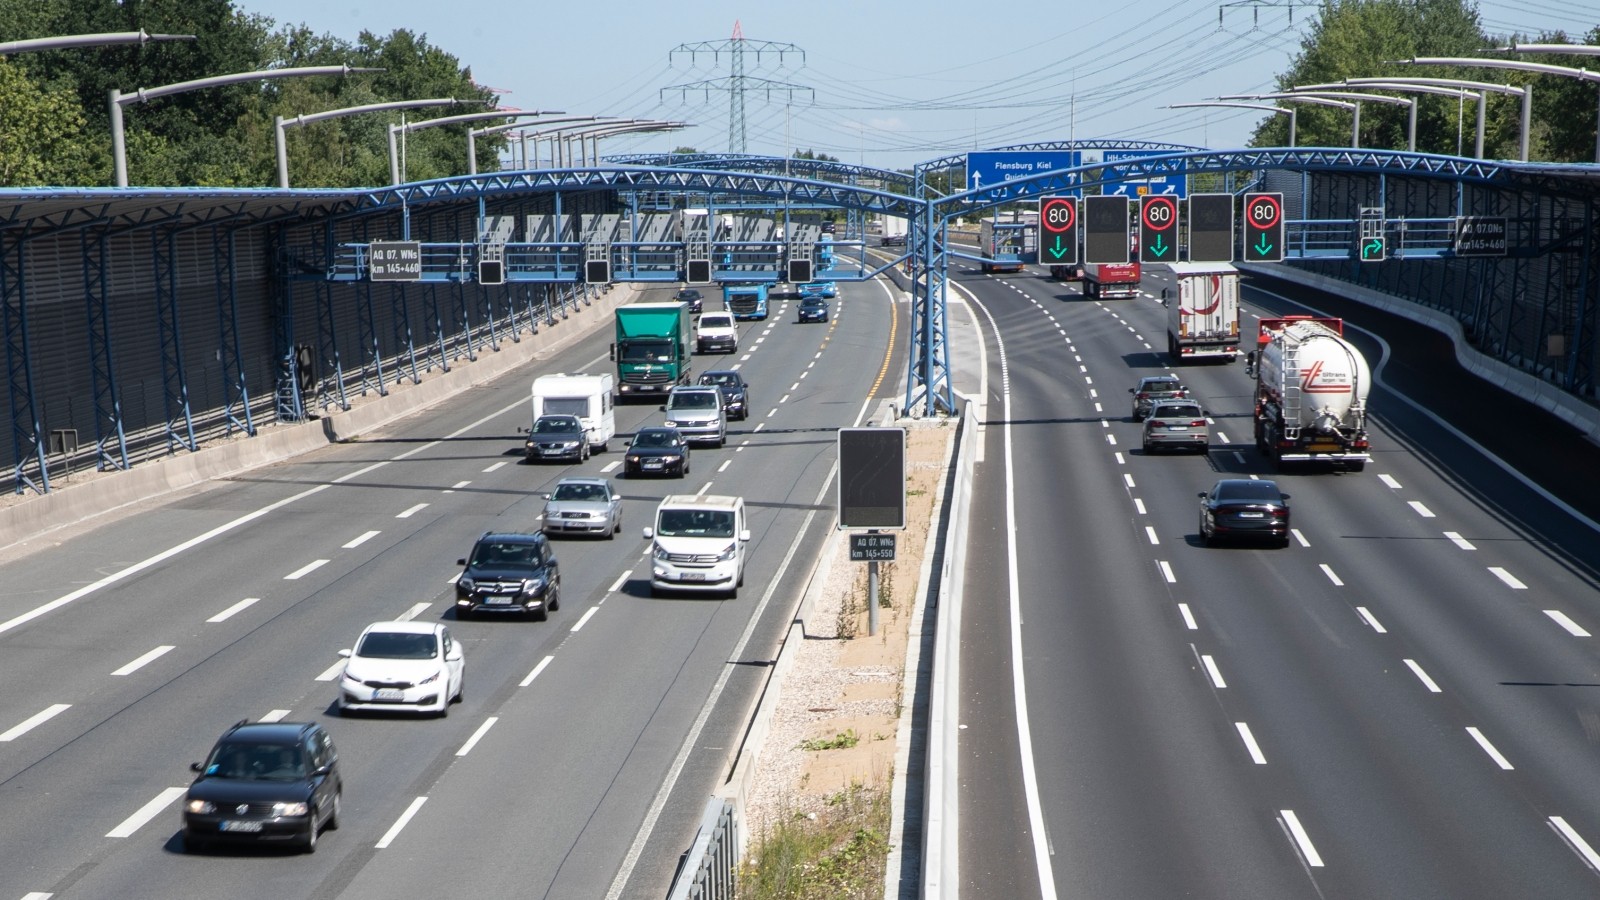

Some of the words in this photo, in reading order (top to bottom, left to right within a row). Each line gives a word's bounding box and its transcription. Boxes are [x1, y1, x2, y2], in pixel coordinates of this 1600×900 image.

[995, 162, 1033, 171] Flensburg
[1036, 161, 1052, 169] Kiel
[1049, 208, 1069, 223] 80
[1149, 206, 1170, 222] 80
[1254, 205, 1274, 220] 80
[373, 250, 384, 260] AQ
[386, 249, 398, 260] 07.
[400, 249, 418, 260] WNs
[371, 263, 384, 274] km
[386, 263, 419, 274] 145+460
[857, 538, 866, 547] AQ
[880, 538, 894, 547] WNs
[852, 549, 863, 558] km
[865, 549, 893, 558] 145+550
